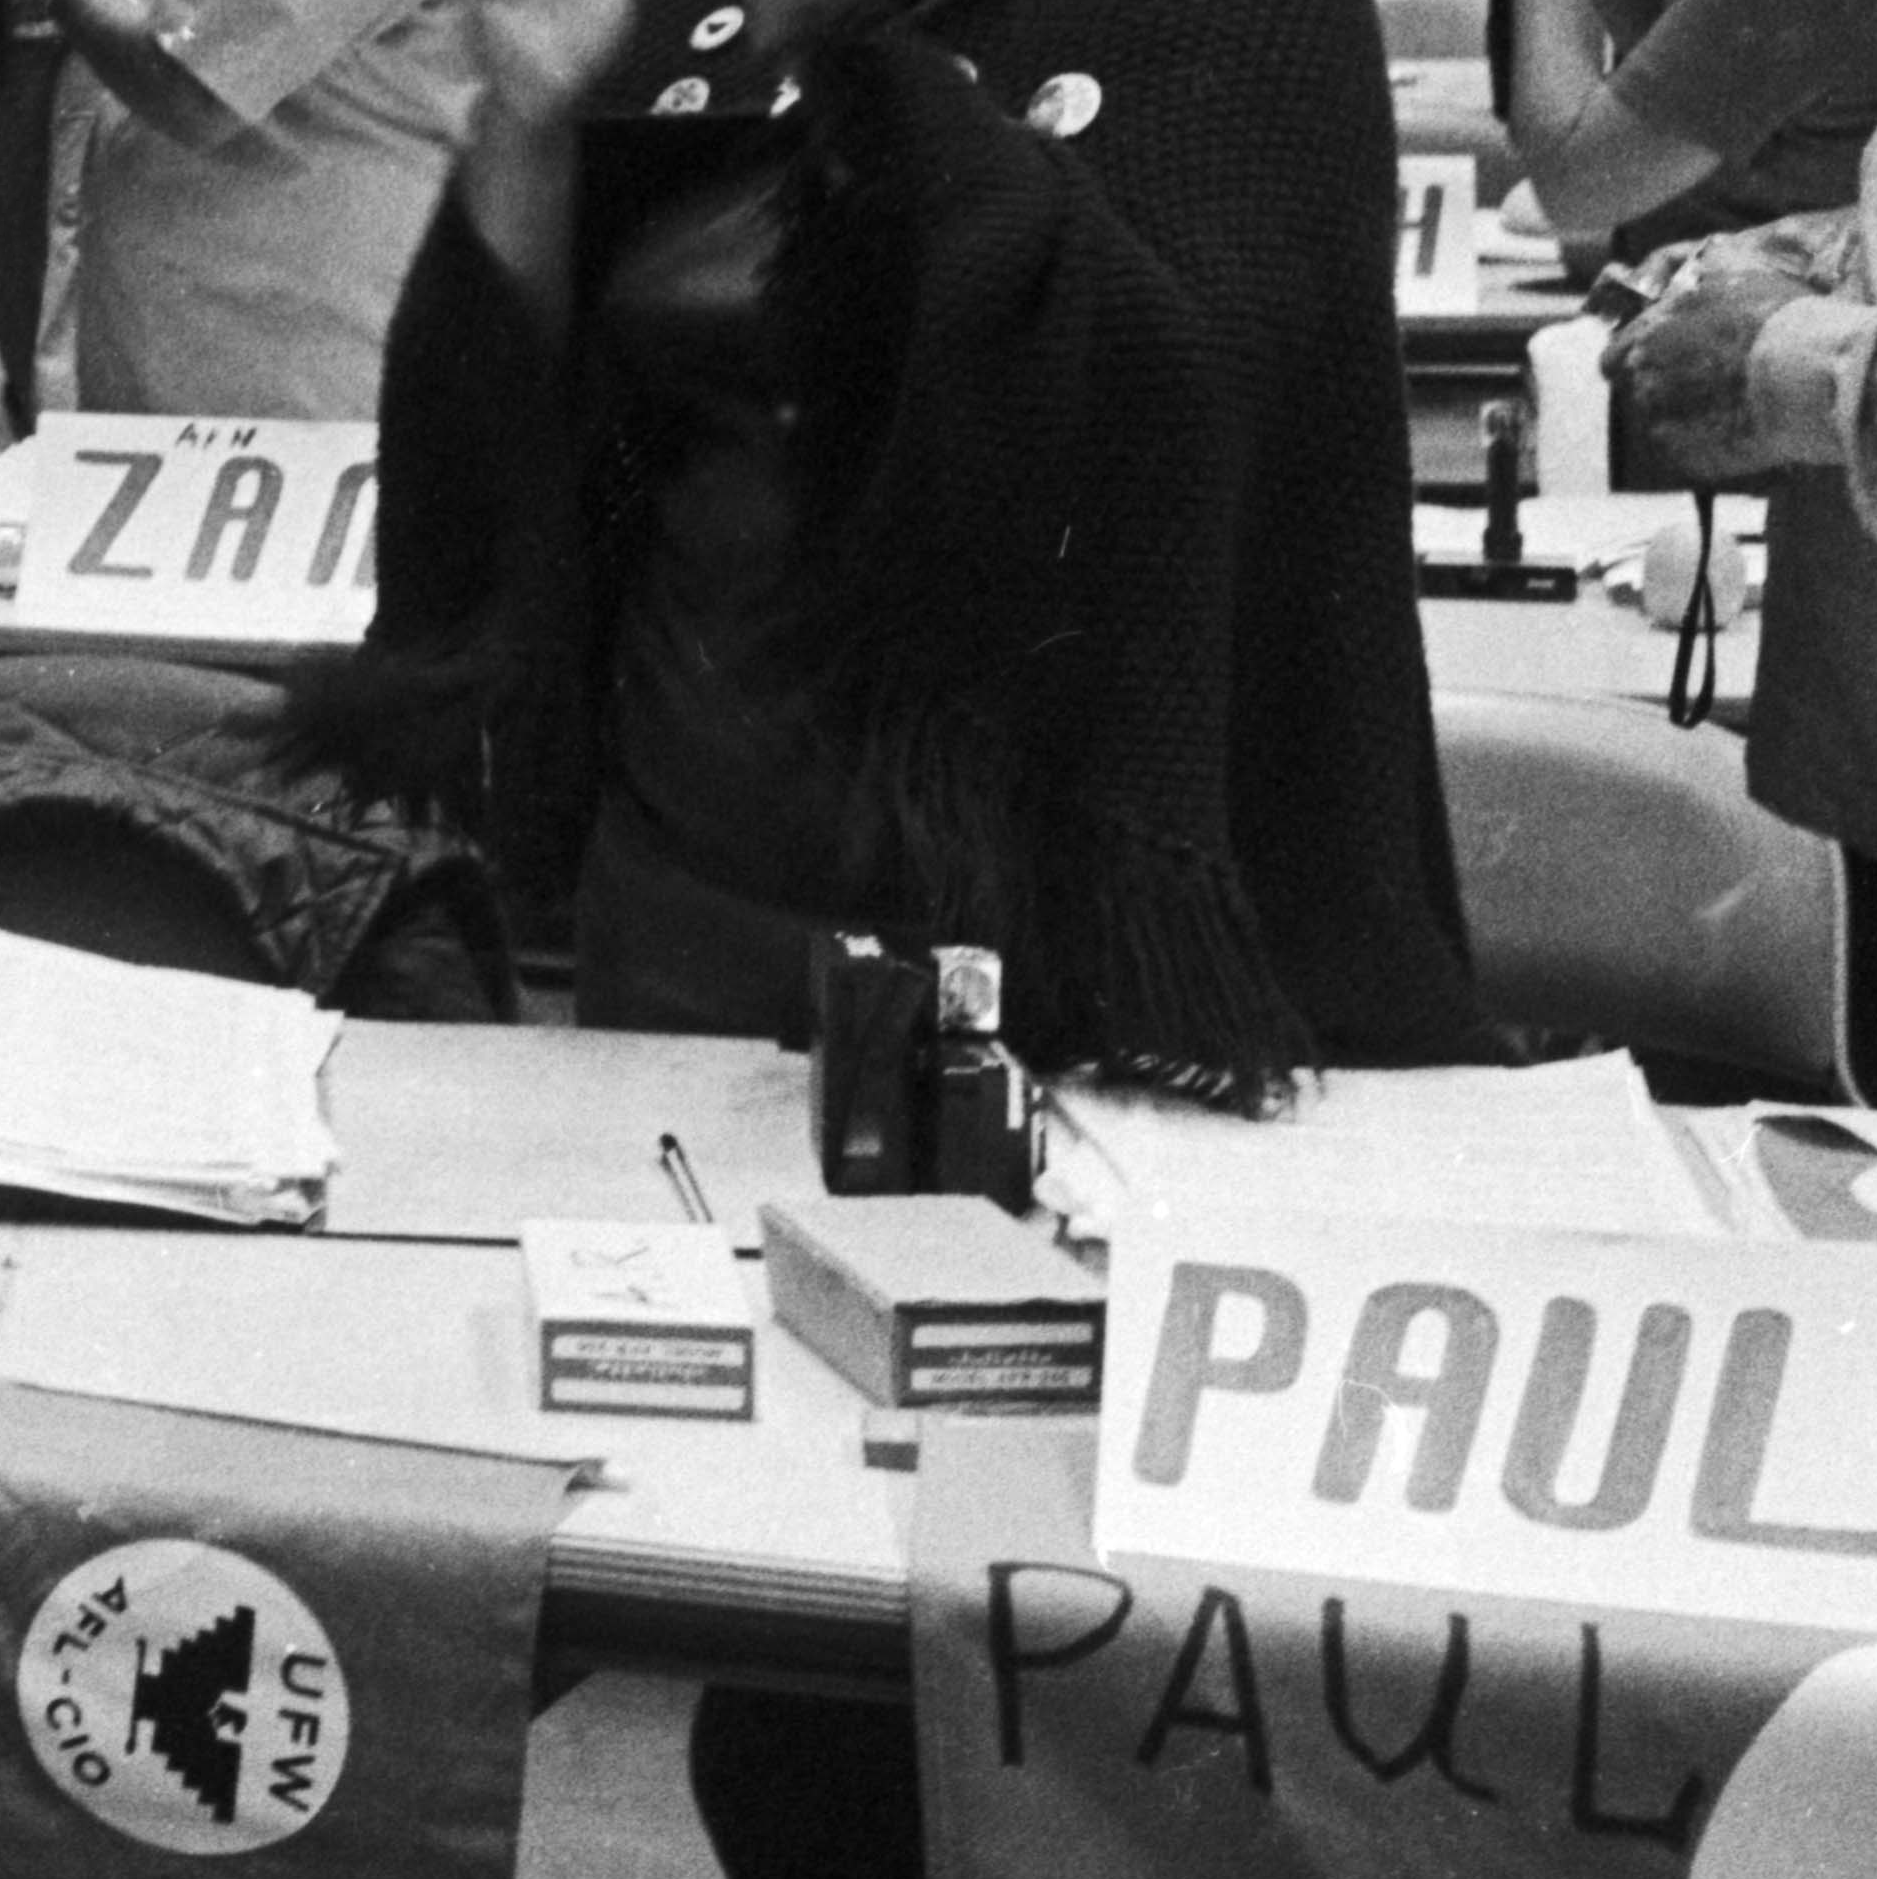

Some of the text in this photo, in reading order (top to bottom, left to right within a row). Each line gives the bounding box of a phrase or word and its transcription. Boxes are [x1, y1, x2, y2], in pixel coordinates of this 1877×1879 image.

[1131, 1261, 1877, 1555] PAUL
[44, 1575, 130, 1789] AFL-CIO
[267, 1651, 328, 1813] UFW
[988, 1560, 1706, 1858] PAUL
